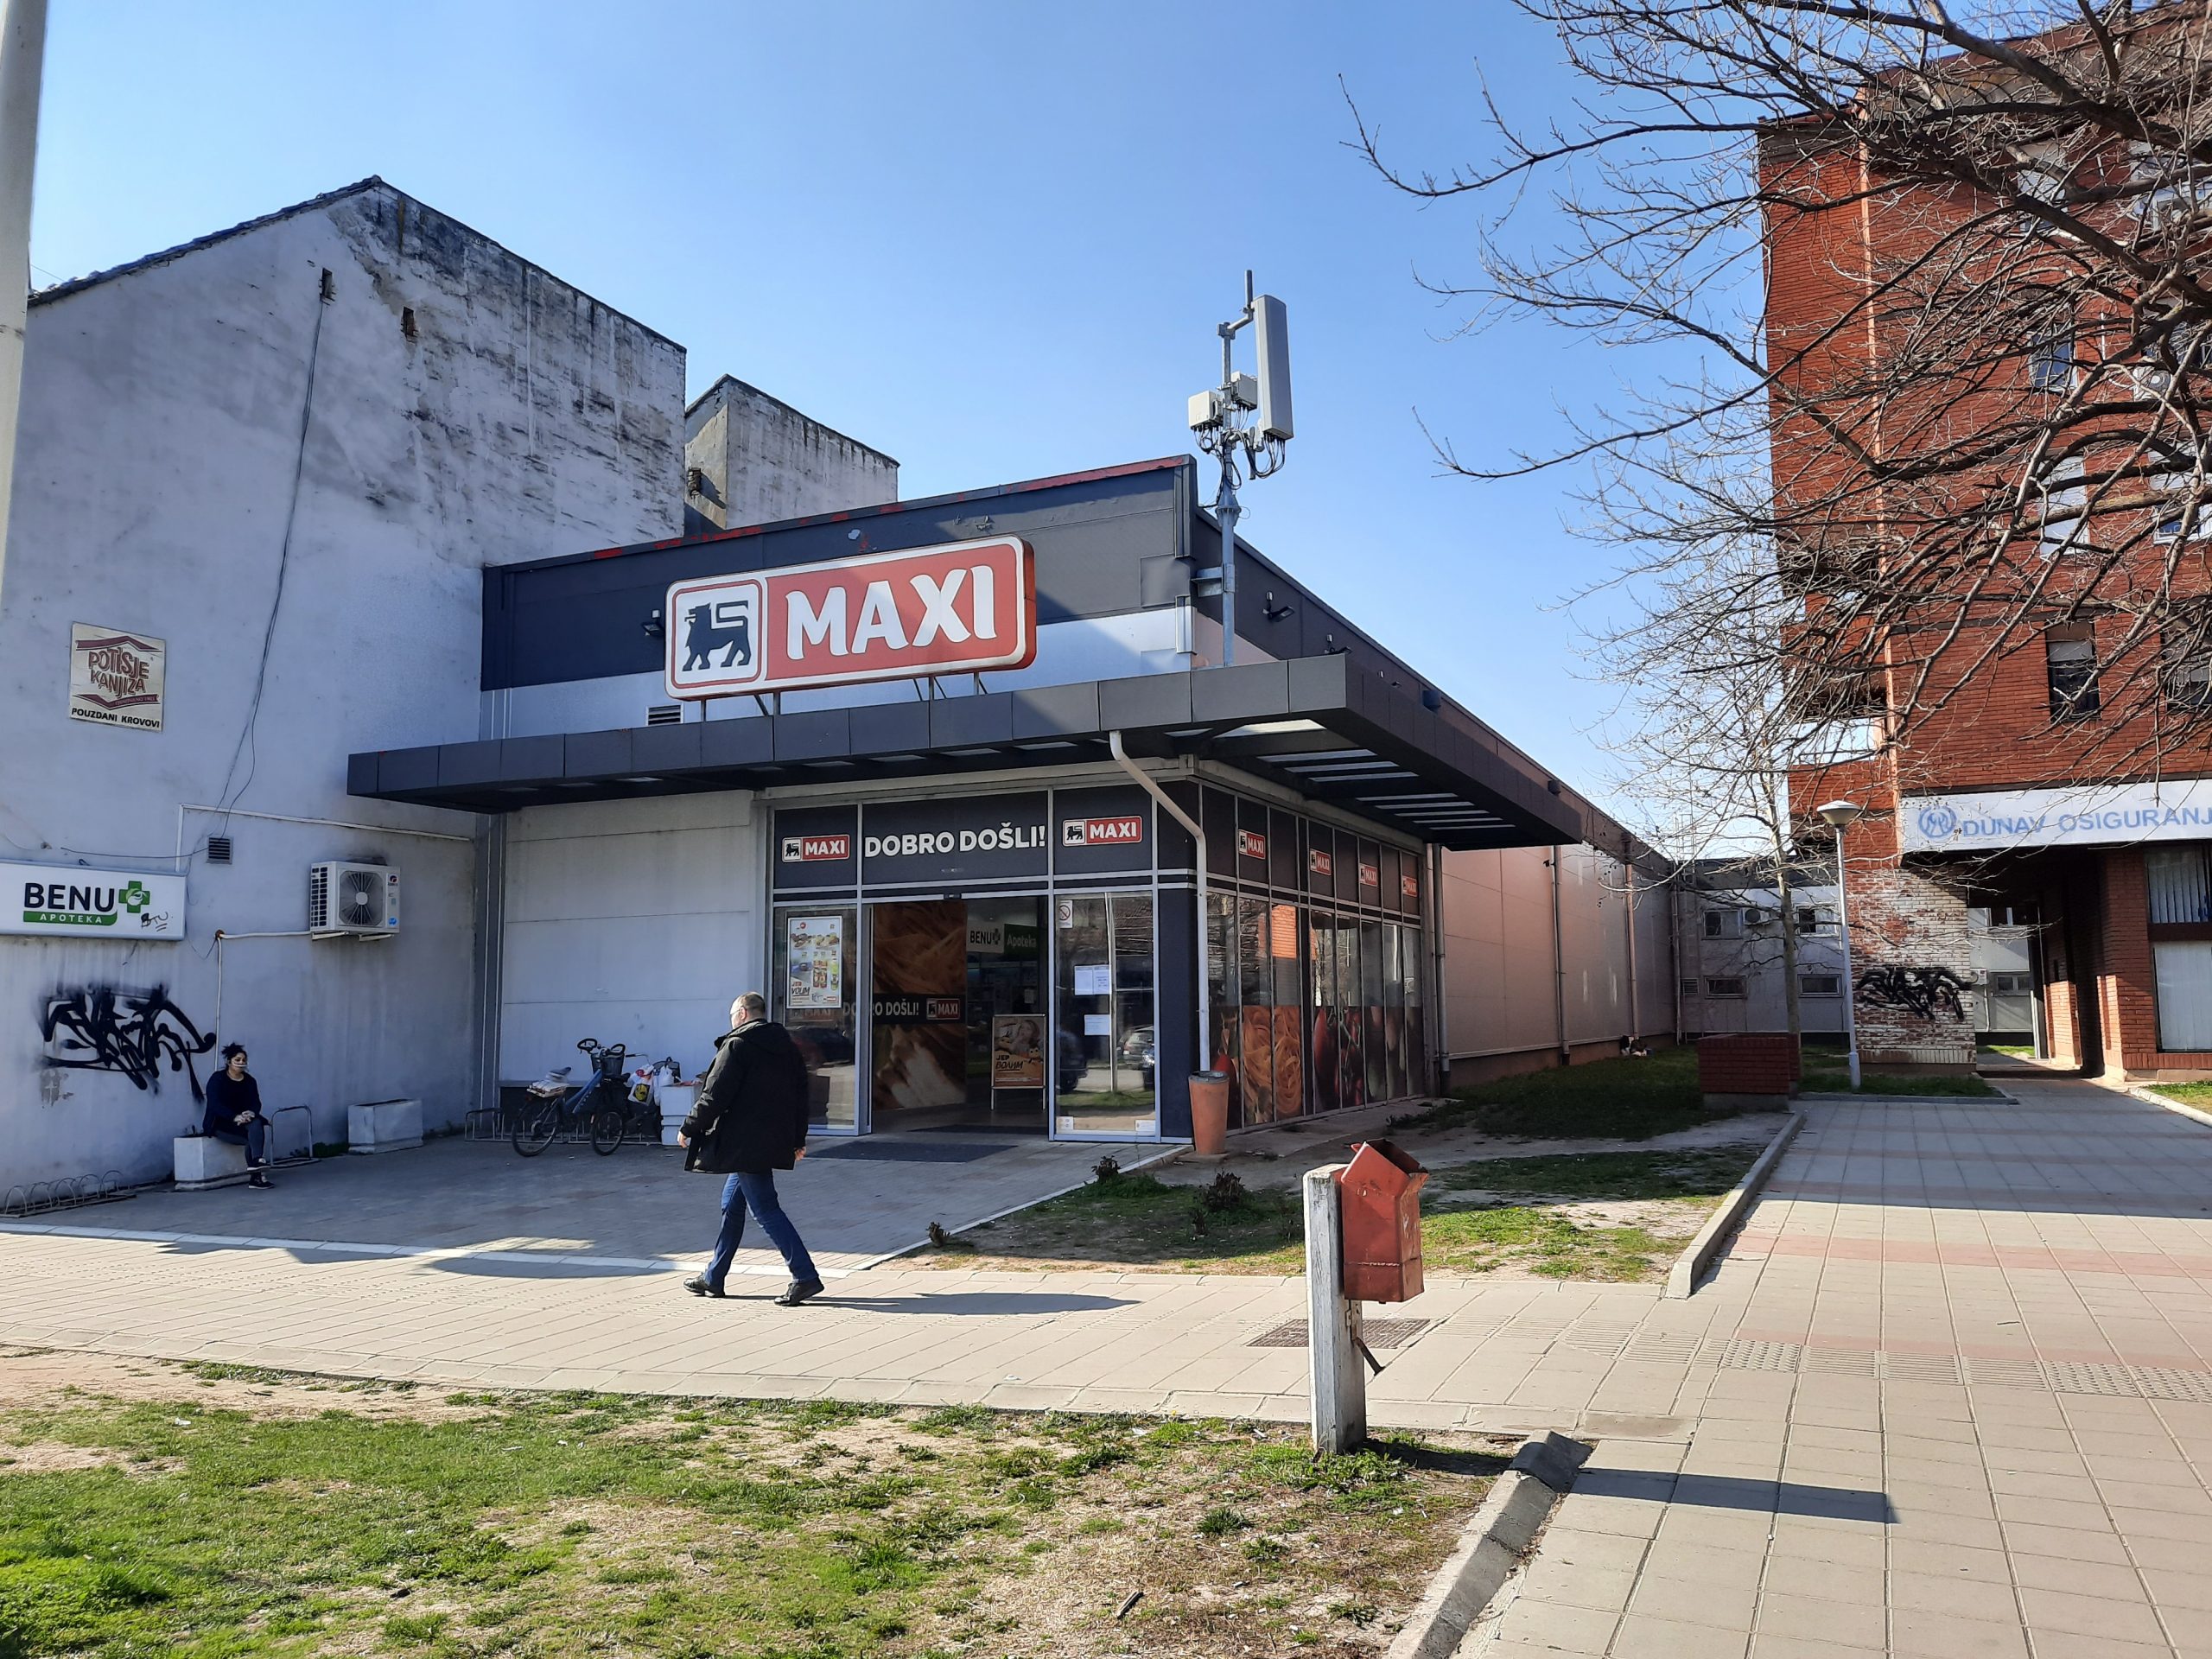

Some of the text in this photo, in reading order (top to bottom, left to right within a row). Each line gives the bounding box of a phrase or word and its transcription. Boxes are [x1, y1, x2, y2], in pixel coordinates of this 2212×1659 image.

[785, 565, 997, 660] MAXI
[88, 647, 149, 679] POTISJE
[71, 708, 160, 728] POUZDANI KROVOVI
[1090, 822, 1137, 839] MAXI
[1962, 815, 2046, 837] DUNAV
[804, 840, 845, 856] MAXI
[865, 822, 1046, 857] DOBRO DOŠLI!
[1248, 836, 1264, 854] MAXI
[1317, 854, 1330, 870] MAXI
[24, 882, 115, 912] BENU
[40, 912, 103, 924] APOTEKA
[969, 930, 992, 944] BENU
[886, 999, 919, 1016] DOŠLI!
[938, 1001, 959, 1015] MAXI
